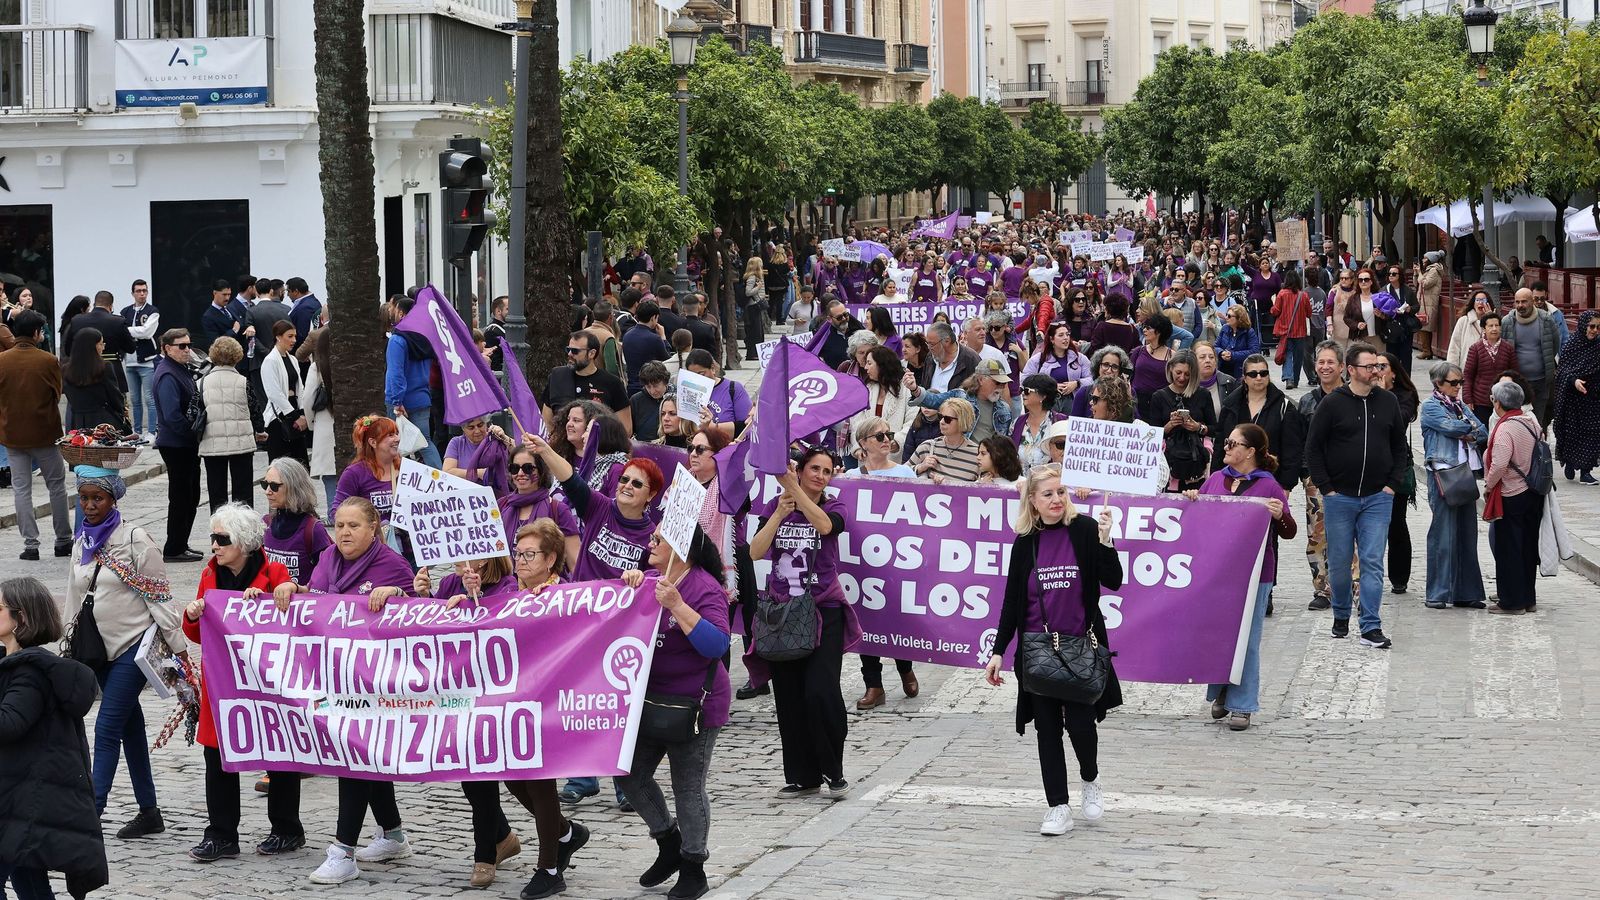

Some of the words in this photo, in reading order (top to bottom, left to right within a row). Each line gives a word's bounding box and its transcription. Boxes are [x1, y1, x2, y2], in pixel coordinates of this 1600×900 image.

[168, 45, 208, 67] AP
[857, 306, 927, 324] MERES
[933, 302, 1026, 322] MIGRES
[1104, 424, 1115, 436] DE
[1118, 427, 1140, 439] UNA
[1069, 433, 1094, 445] GRAN
[1126, 440, 1145, 451] HAY
[1146, 442, 1160, 453] UN
[1064, 458, 1101, 473] QUIERE
[1067, 446, 1123, 461] ACOMPLEJAO
[1125, 452, 1143, 465] QUE
[1146, 456, 1158, 467] LA
[410, 497, 466, 516] APARENTA
[468, 496, 488, 511] EN
[856, 489, 952, 528] LAS
[967, 496, 1183, 542] MRES
[412, 519, 426, 532] LA
[430, 513, 466, 530] CALLE
[473, 510, 488, 524] LO
[777, 526, 818, 538] FEMINISM
[416, 531, 441, 547] QUE
[445, 529, 463, 543] NO
[467, 524, 499, 540] ERES
[420, 547, 440, 561] EN
[447, 545, 464, 558] LA
[465, 541, 495, 555] CASA
[838, 532, 924, 570] LOS
[1038, 571, 1064, 581] OLIVAR
[1042, 581, 1070, 590] RIVERO
[222, 597, 317, 627] FRENTE
[328, 600, 365, 629] AL
[496, 586, 635, 619] DESATADO
[900, 581, 990, 619] LOS
[862, 631, 888, 645] area
[890, 633, 933, 650] Violeta
[936, 639, 971, 654] Jerez
[229, 632, 515, 697] FEMINISMO
[378, 697, 435, 709] PALESTINA
[558, 689, 618, 712] Marea
[562, 715, 610, 731] Violeta
[227, 704, 535, 767] ORGANIZADO
